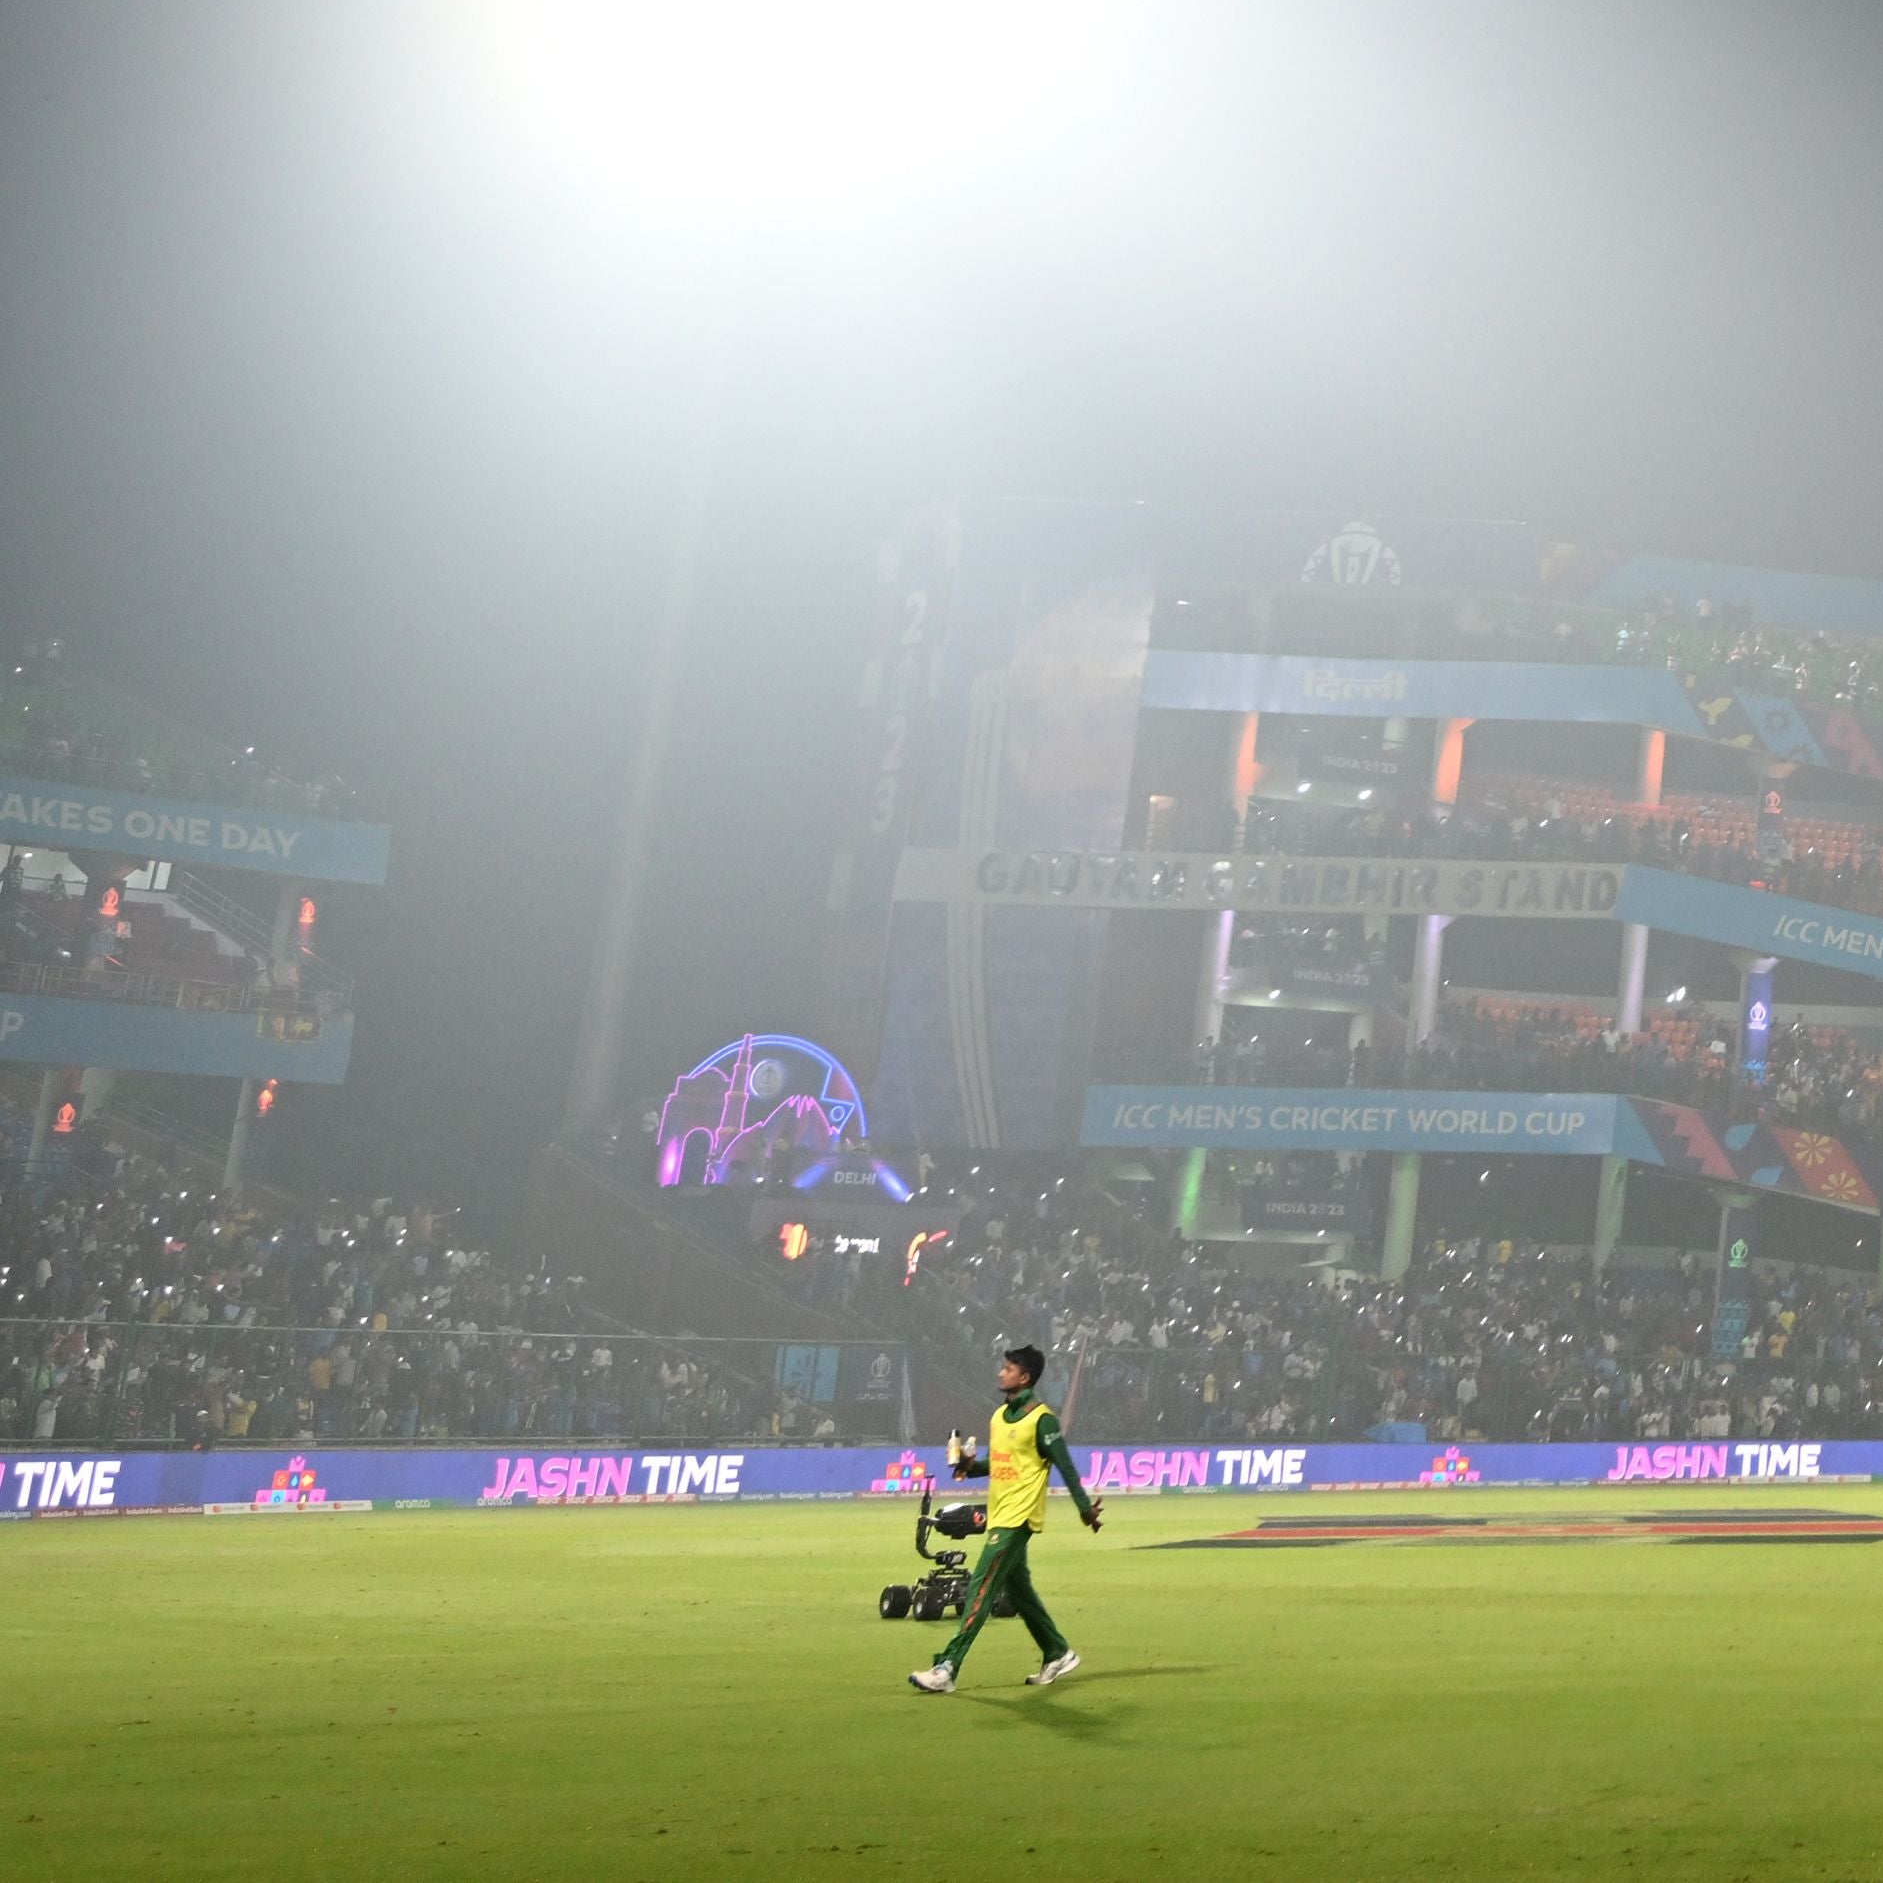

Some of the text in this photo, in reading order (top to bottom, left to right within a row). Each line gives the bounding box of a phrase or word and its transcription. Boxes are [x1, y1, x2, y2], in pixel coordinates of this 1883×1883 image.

[124, 810, 210, 847] ONE
[221, 822, 303, 860] DAY
[975, 852, 1619, 911] GAUTAM GAMBHIR STAND
[1773, 914, 1823, 944] ICC
[1113, 1103, 1586, 1136] ICC MEN'S CRICKET WORLD CUP
[834, 1171, 877, 1185] DELHI
[1266, 1201, 1306, 1215] INDIA
[483, 1455, 745, 1498] JASHN TIME
[1080, 1449, 1306, 1488] JASHN TIME
[1608, 1444, 1822, 1480] JASHN TIME
[14, 1461, 121, 1507] TIME
[395, 1500, 431, 1508] aramco
[477, 1497, 512, 1506] aramco
